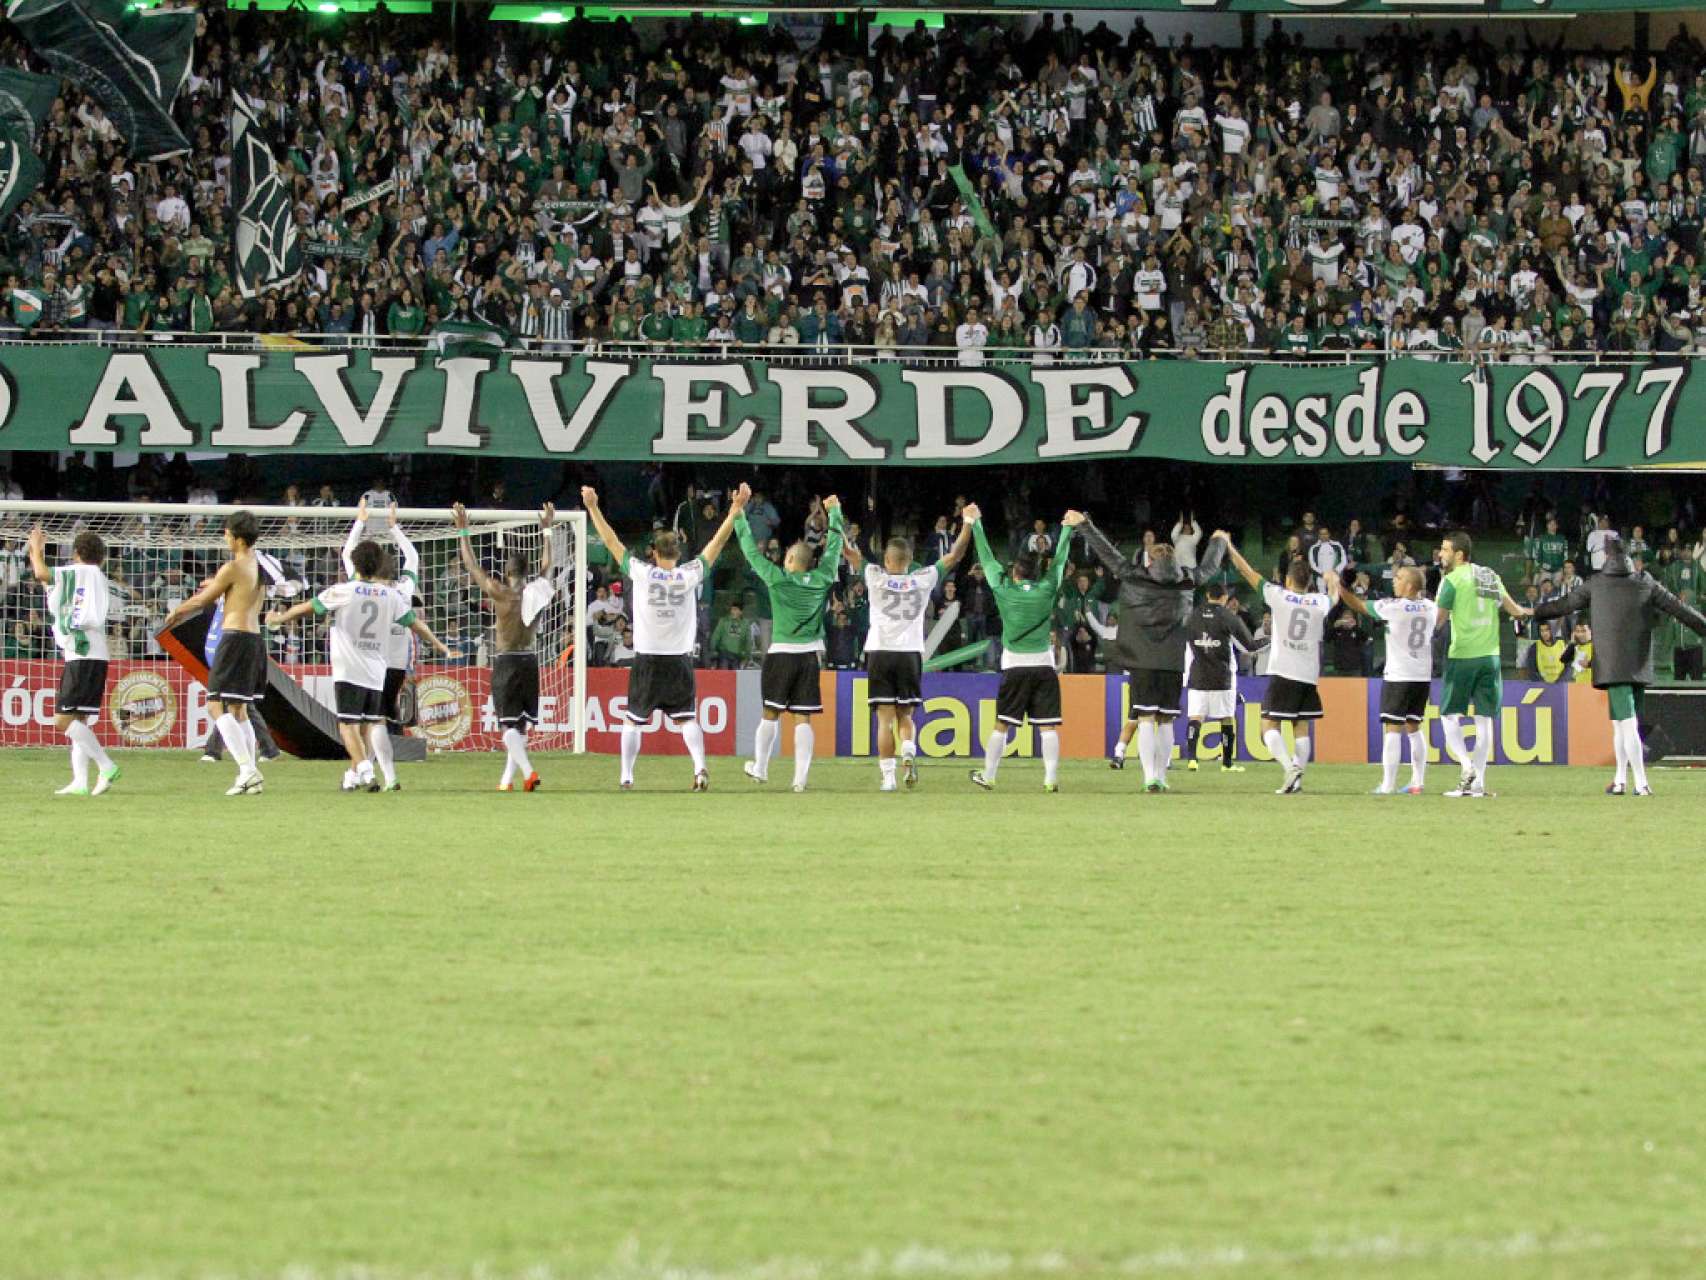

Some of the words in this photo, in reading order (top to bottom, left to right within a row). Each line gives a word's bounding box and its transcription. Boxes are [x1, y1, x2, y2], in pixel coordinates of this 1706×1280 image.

[69, 352, 1147, 460] ALVIVERDE
[1201, 366, 1428, 459] desde
[1461, 365, 1690, 465] 1977
[359, 600, 379, 639] 2
[881, 589, 922, 621] 23
[1287, 607, 1311, 641] 6
[1407, 616, 1427, 650] 8
